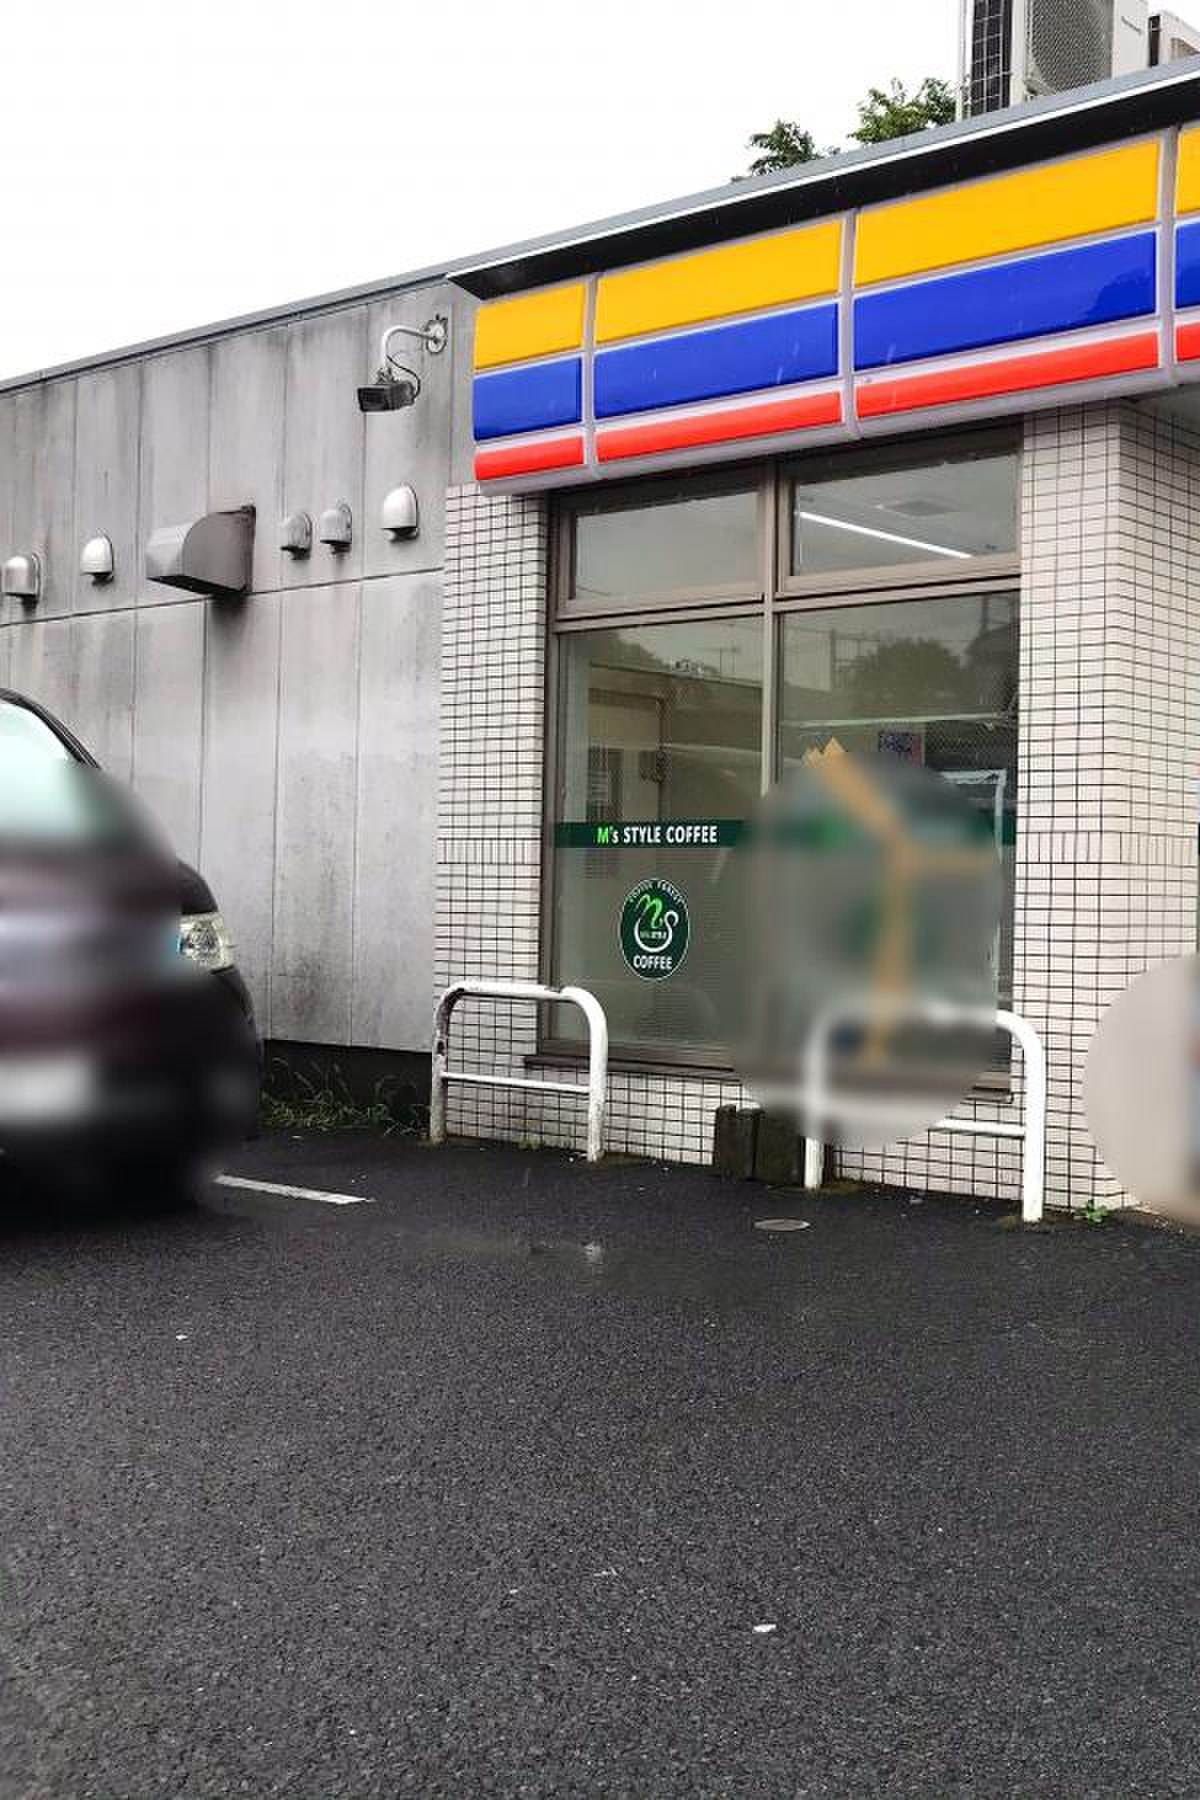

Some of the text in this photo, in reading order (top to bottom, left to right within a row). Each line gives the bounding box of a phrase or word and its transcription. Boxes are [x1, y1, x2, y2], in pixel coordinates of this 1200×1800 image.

[597, 825, 718, 844] M's STYLE COFFEE
[633, 954, 673, 970] COFFEE
